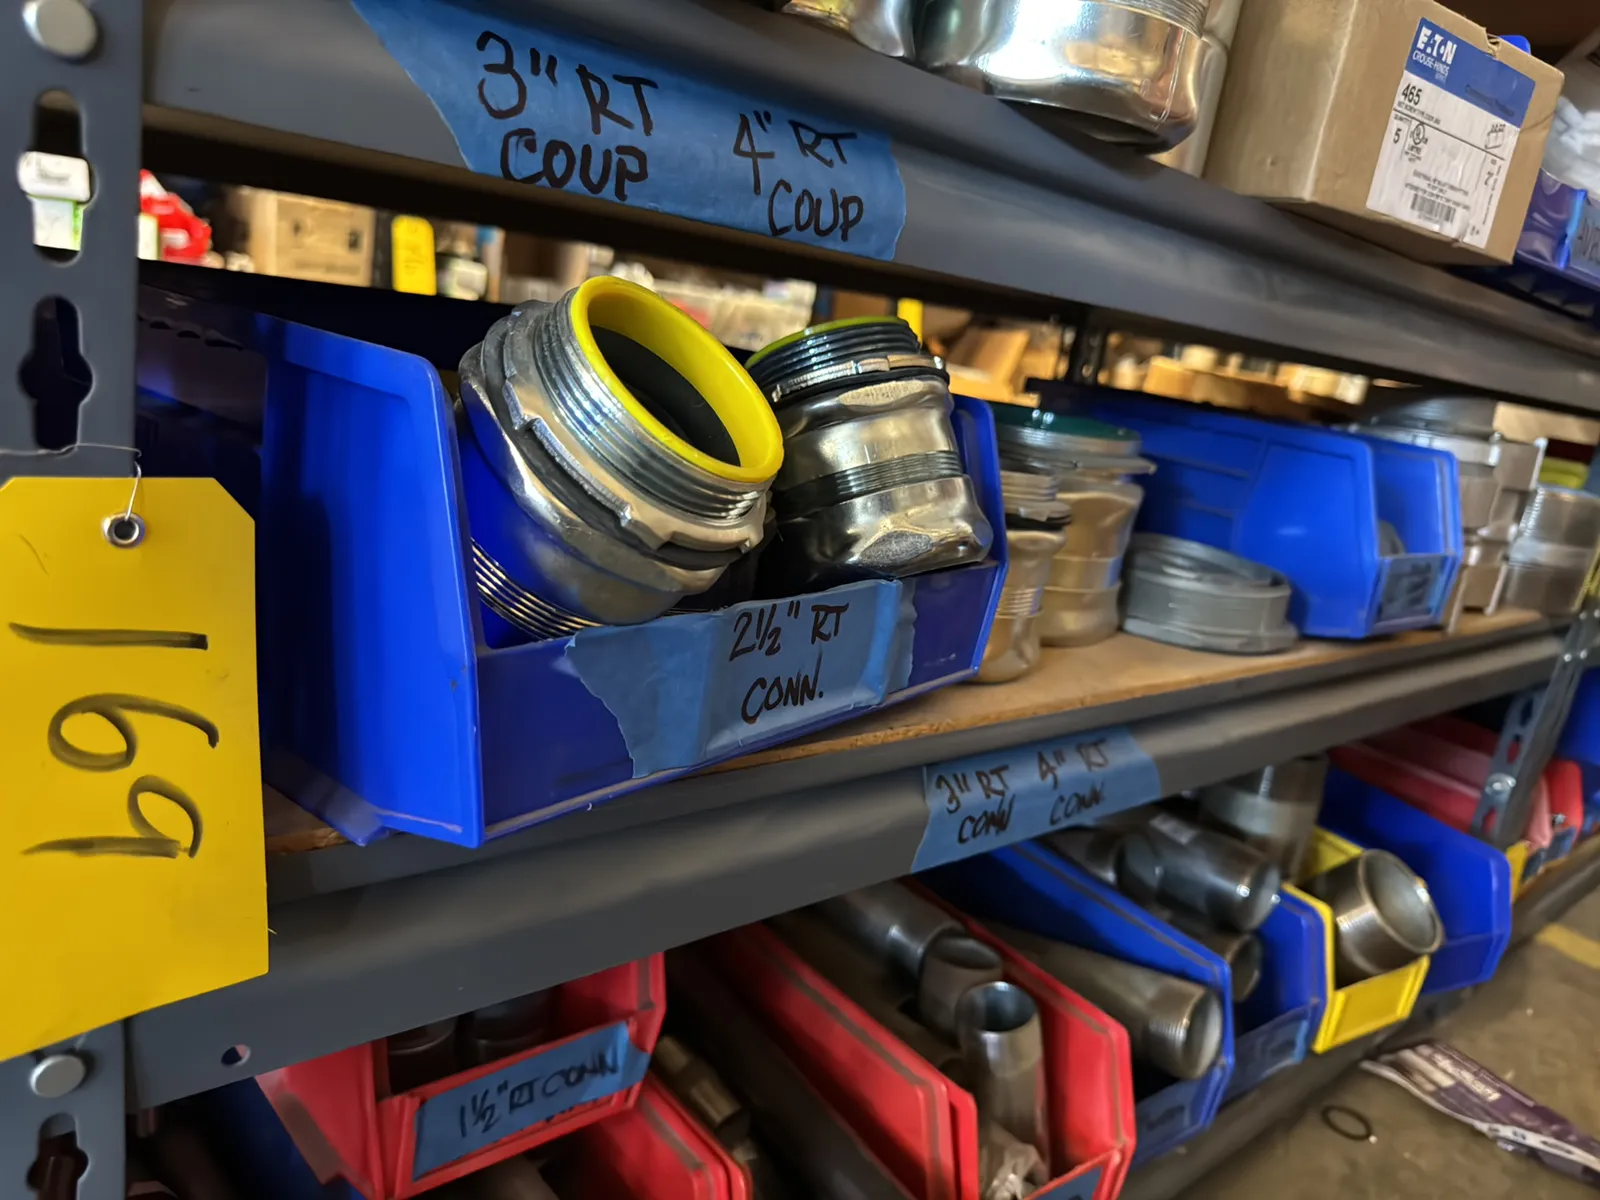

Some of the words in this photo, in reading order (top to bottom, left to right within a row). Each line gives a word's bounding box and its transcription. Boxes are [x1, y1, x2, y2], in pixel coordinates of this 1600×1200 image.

[576, 63, 658, 136] RT
[1402, 83, 1422, 106] 465
[788, 118, 858, 168] RT
[1393, 128, 1402, 144] 5
[501, 127, 649, 201] COUP
[767, 179, 864, 242] COUP
[810, 602, 850, 645] RT
[1075, 737, 1110, 773] RT
[974, 764, 1010, 799] RT
[509, 1076, 541, 1115] RT
